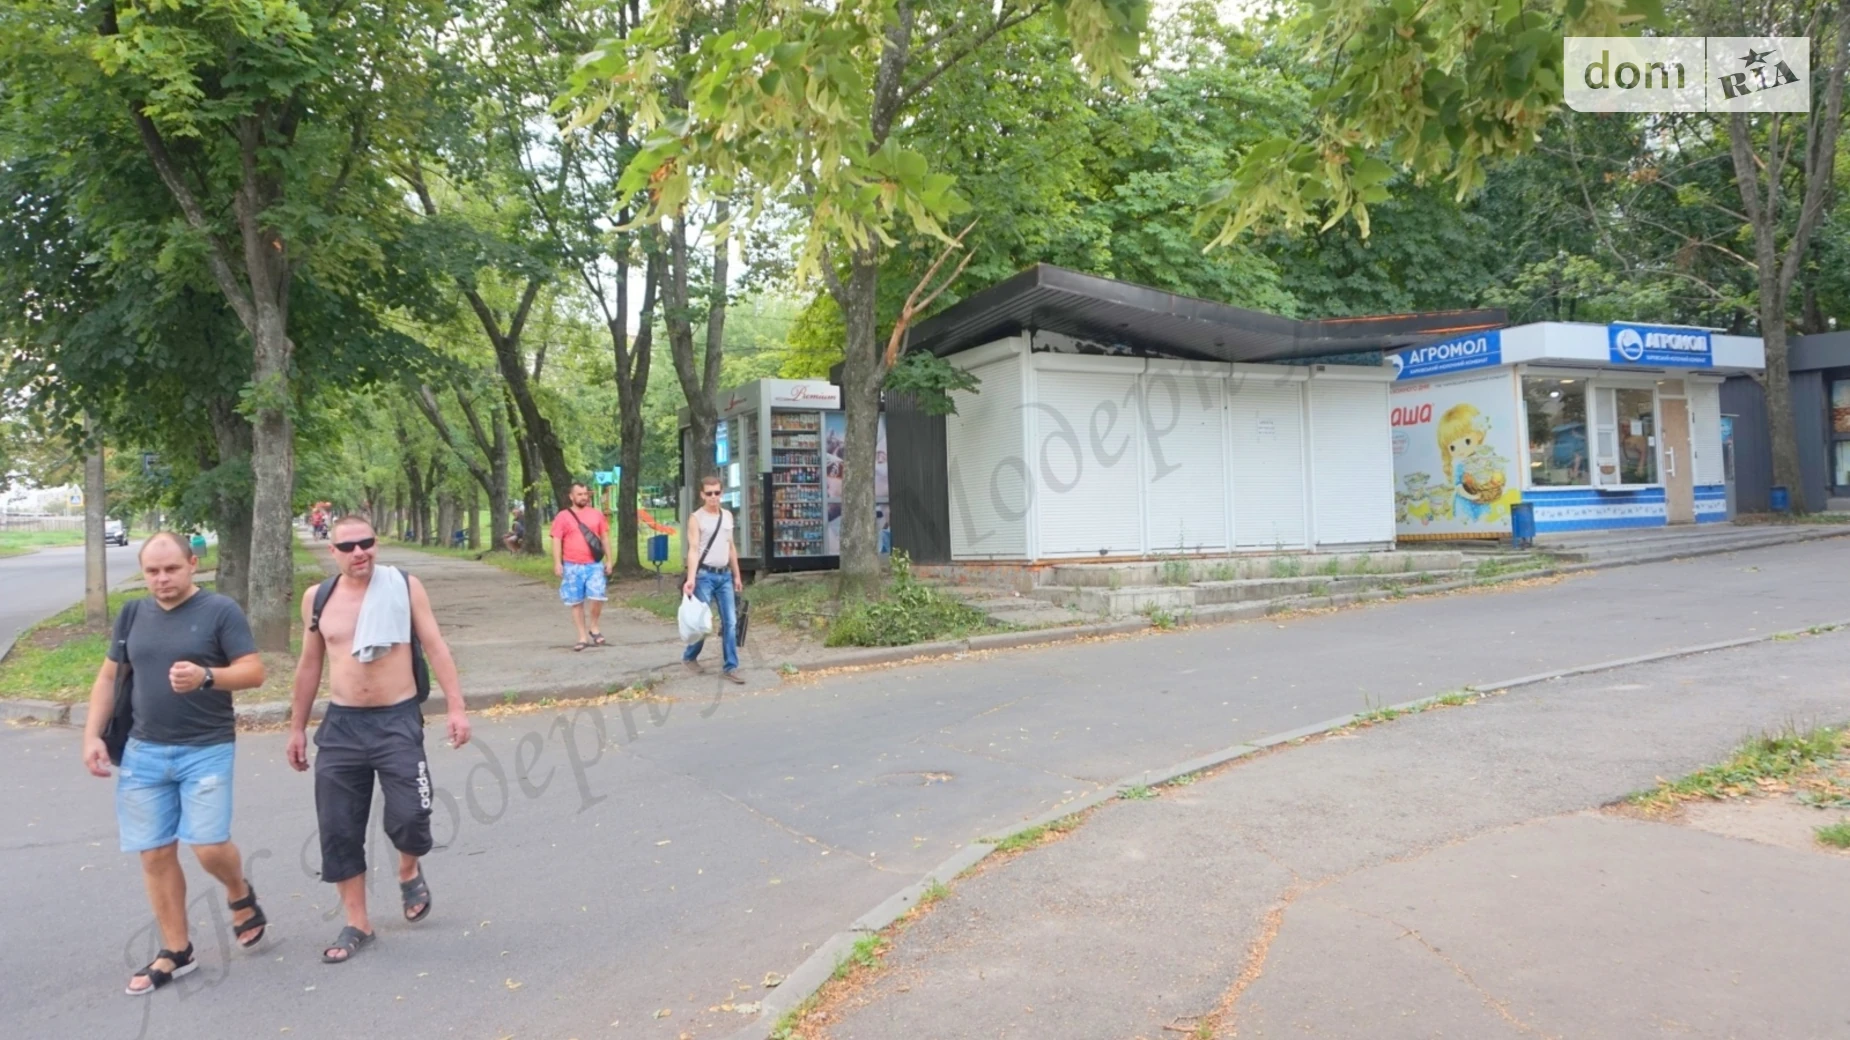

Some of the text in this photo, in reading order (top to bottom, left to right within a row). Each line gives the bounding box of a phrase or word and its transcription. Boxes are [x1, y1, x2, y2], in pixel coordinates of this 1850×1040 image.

[1409, 337, 1487, 365] АГРОМОЛ
[1645, 332, 1708, 352] АГРОМОЛ
[775, 384, 837, 402] Premium
